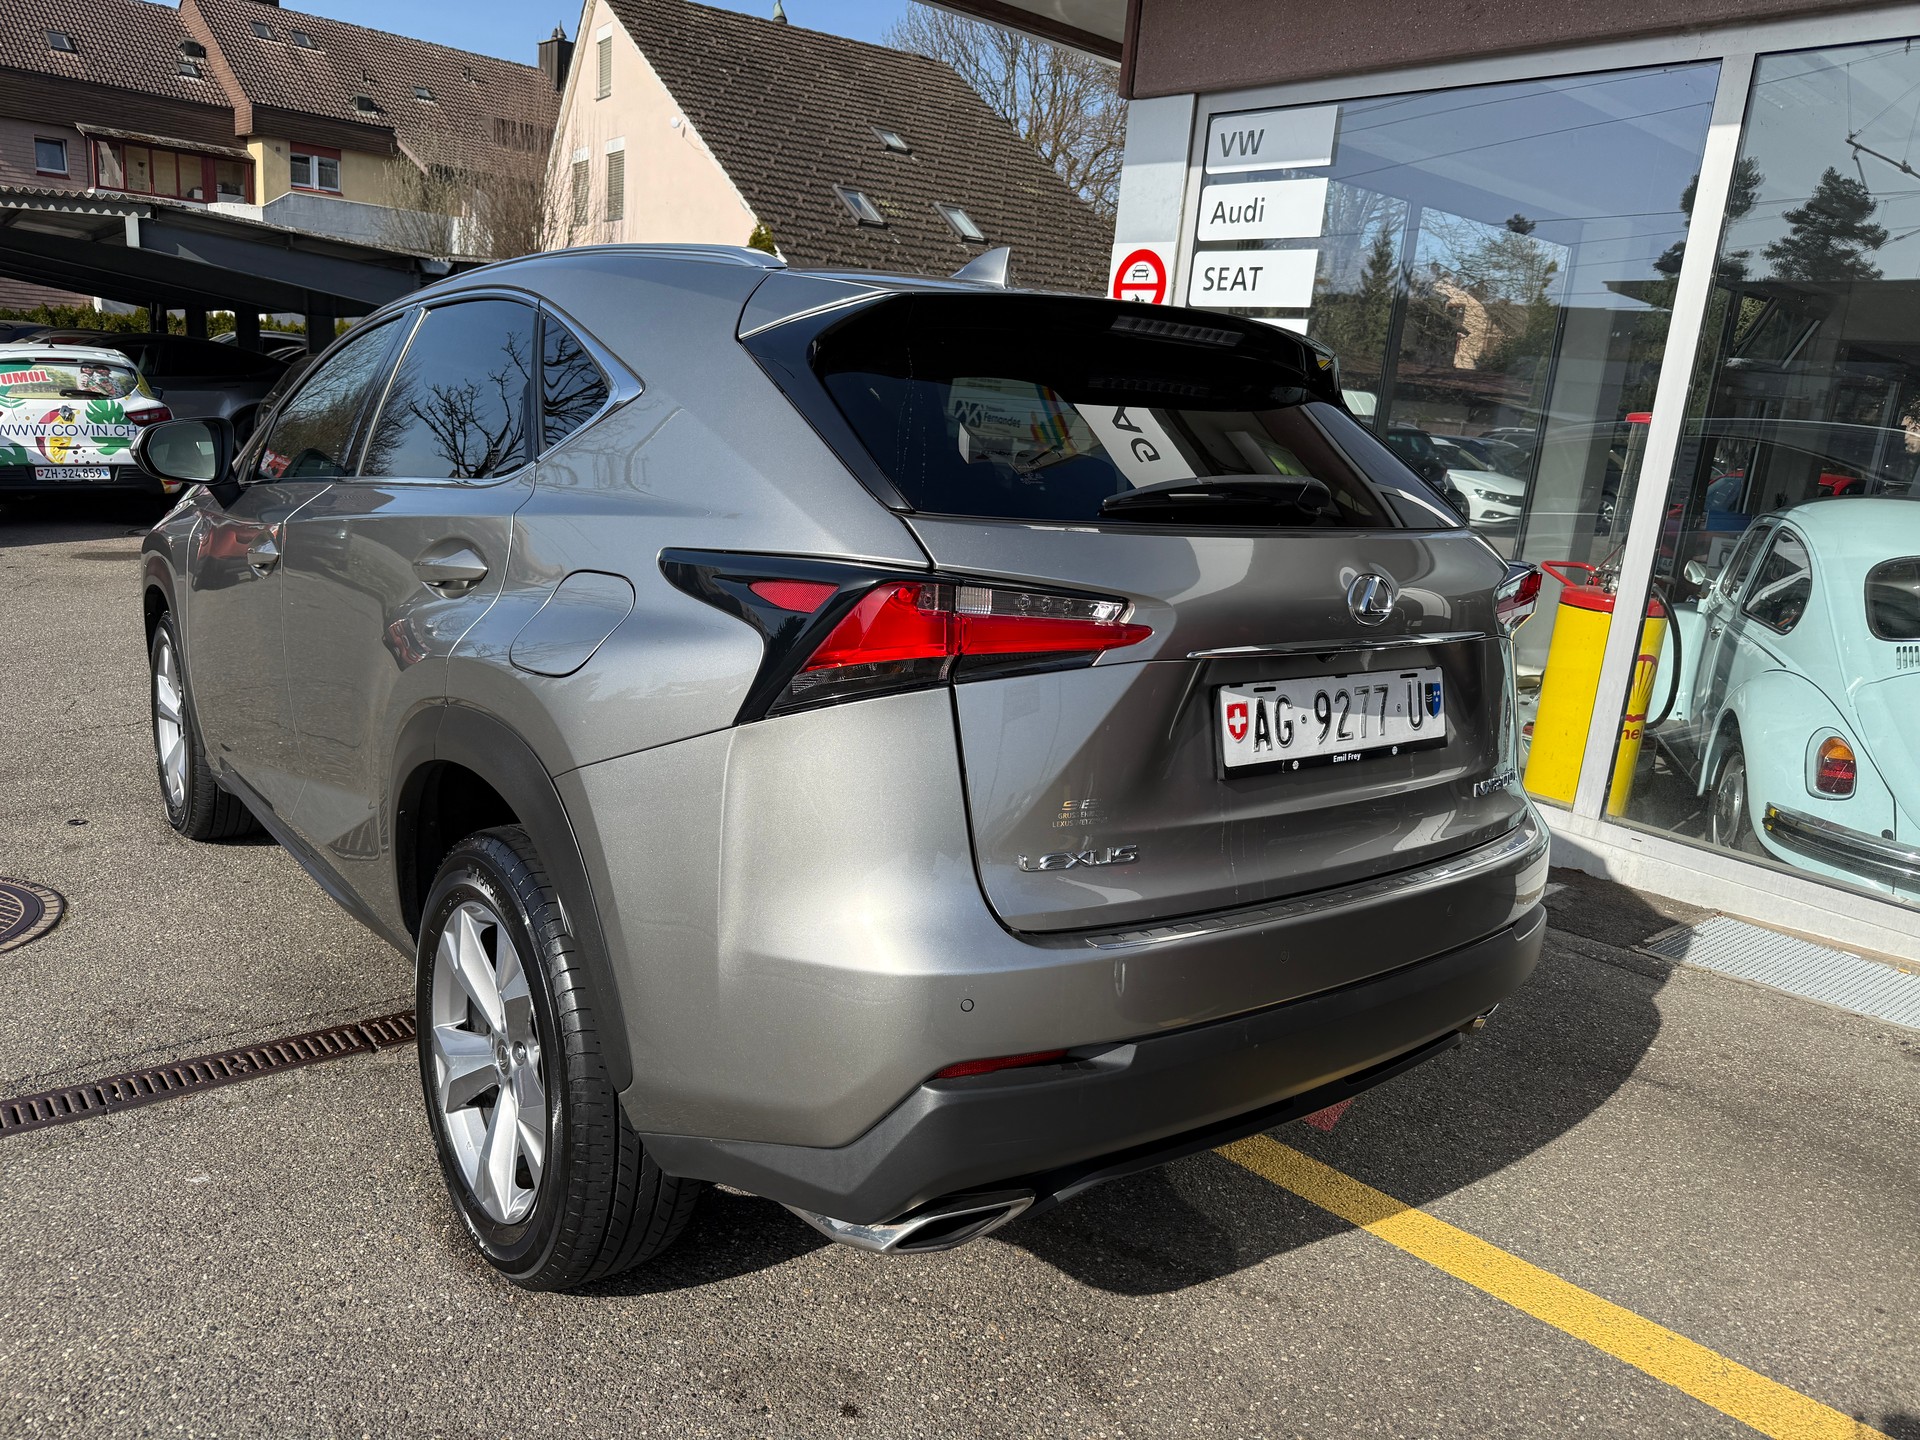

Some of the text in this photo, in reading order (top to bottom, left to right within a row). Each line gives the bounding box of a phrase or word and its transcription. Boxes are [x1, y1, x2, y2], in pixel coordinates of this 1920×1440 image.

[1220, 128, 1265, 157] VW
[1210, 197, 1265, 224] Audi
[1203, 266, 1263, 292] SEAT
[984, 412, 1022, 428] Fernandes
[1313, 683, 1389, 745] 9277
[1333, 752, 1361, 763] Emil Frey
[1018, 844, 1138, 872] LEXUS
